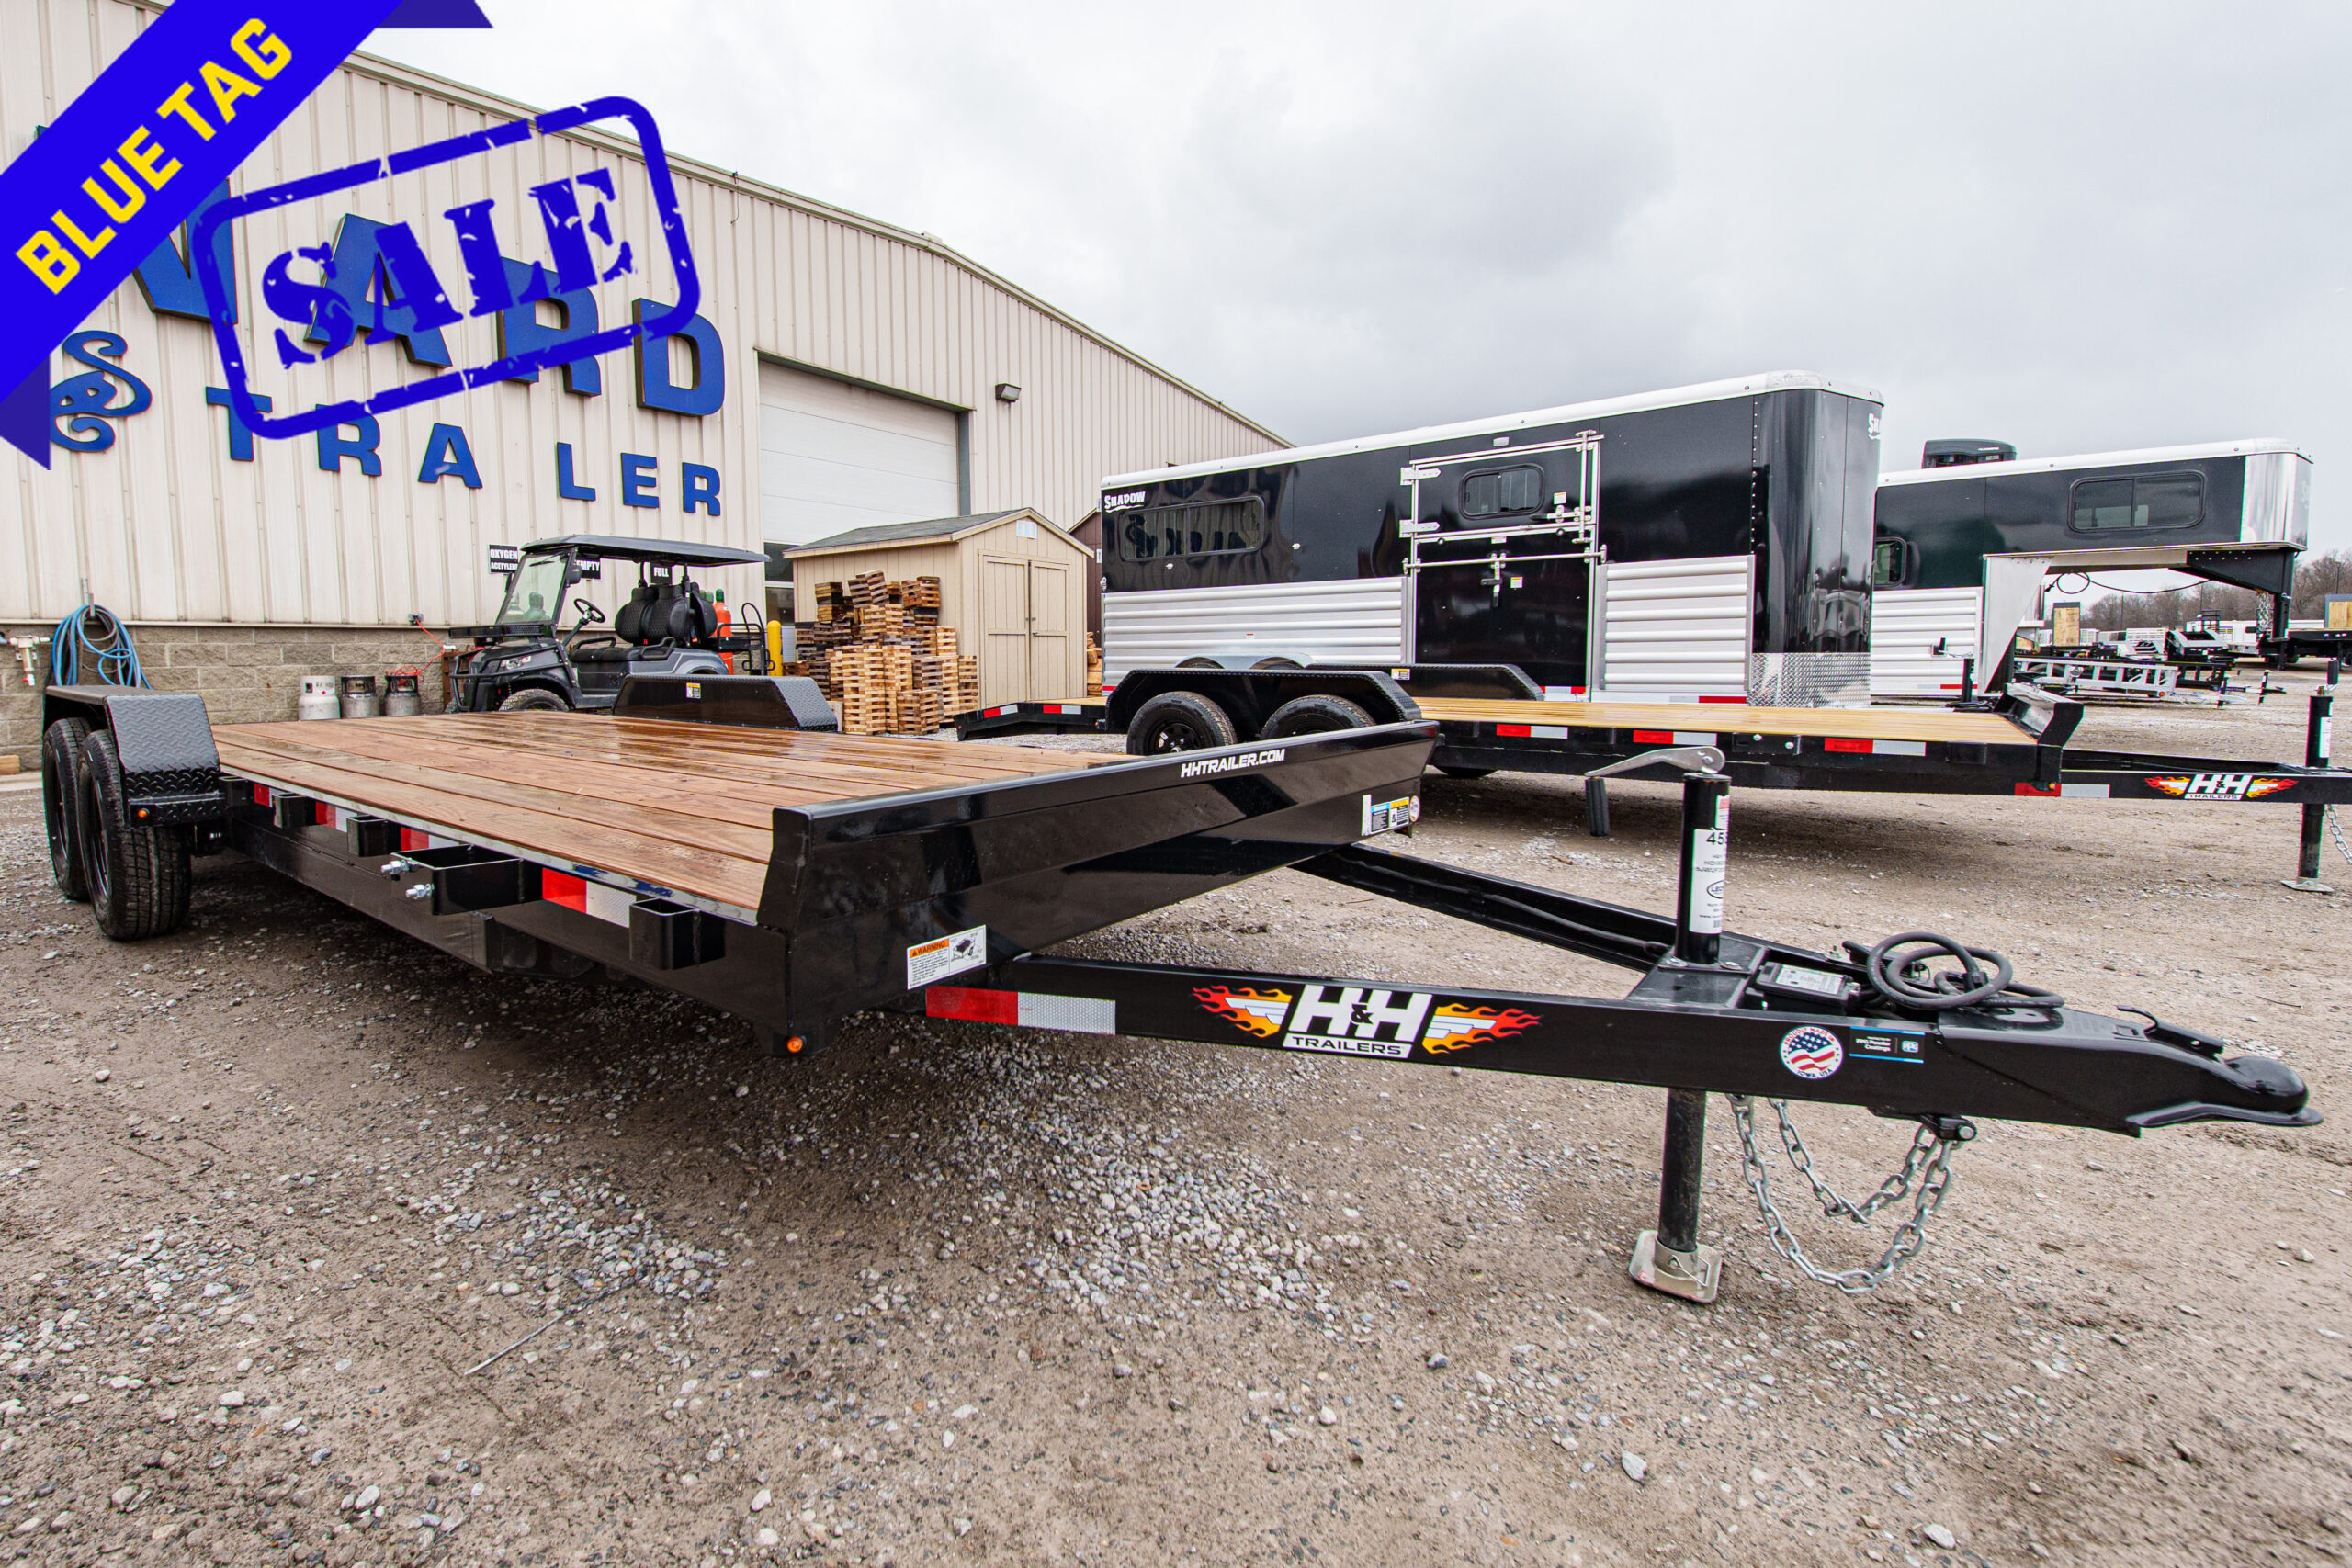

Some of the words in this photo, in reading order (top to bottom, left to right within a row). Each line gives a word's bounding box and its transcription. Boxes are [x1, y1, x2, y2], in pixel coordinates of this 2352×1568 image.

[490, 548, 518, 560] OXYGEN
[491, 561, 519, 570] ACETYLEN
[653, 567, 670, 578] FULL
[1181, 748, 1286, 778] HHTRAILER.COM
[2187, 773, 2254, 795] H&H
[1706, 831, 1728, 846] 45
[918, 940, 946, 954] WARNING
[1288, 984, 1432, 1043] H&H
[1291, 1035, 1403, 1055] TRAILERS
[1820, 1067, 1834, 1077] USA
